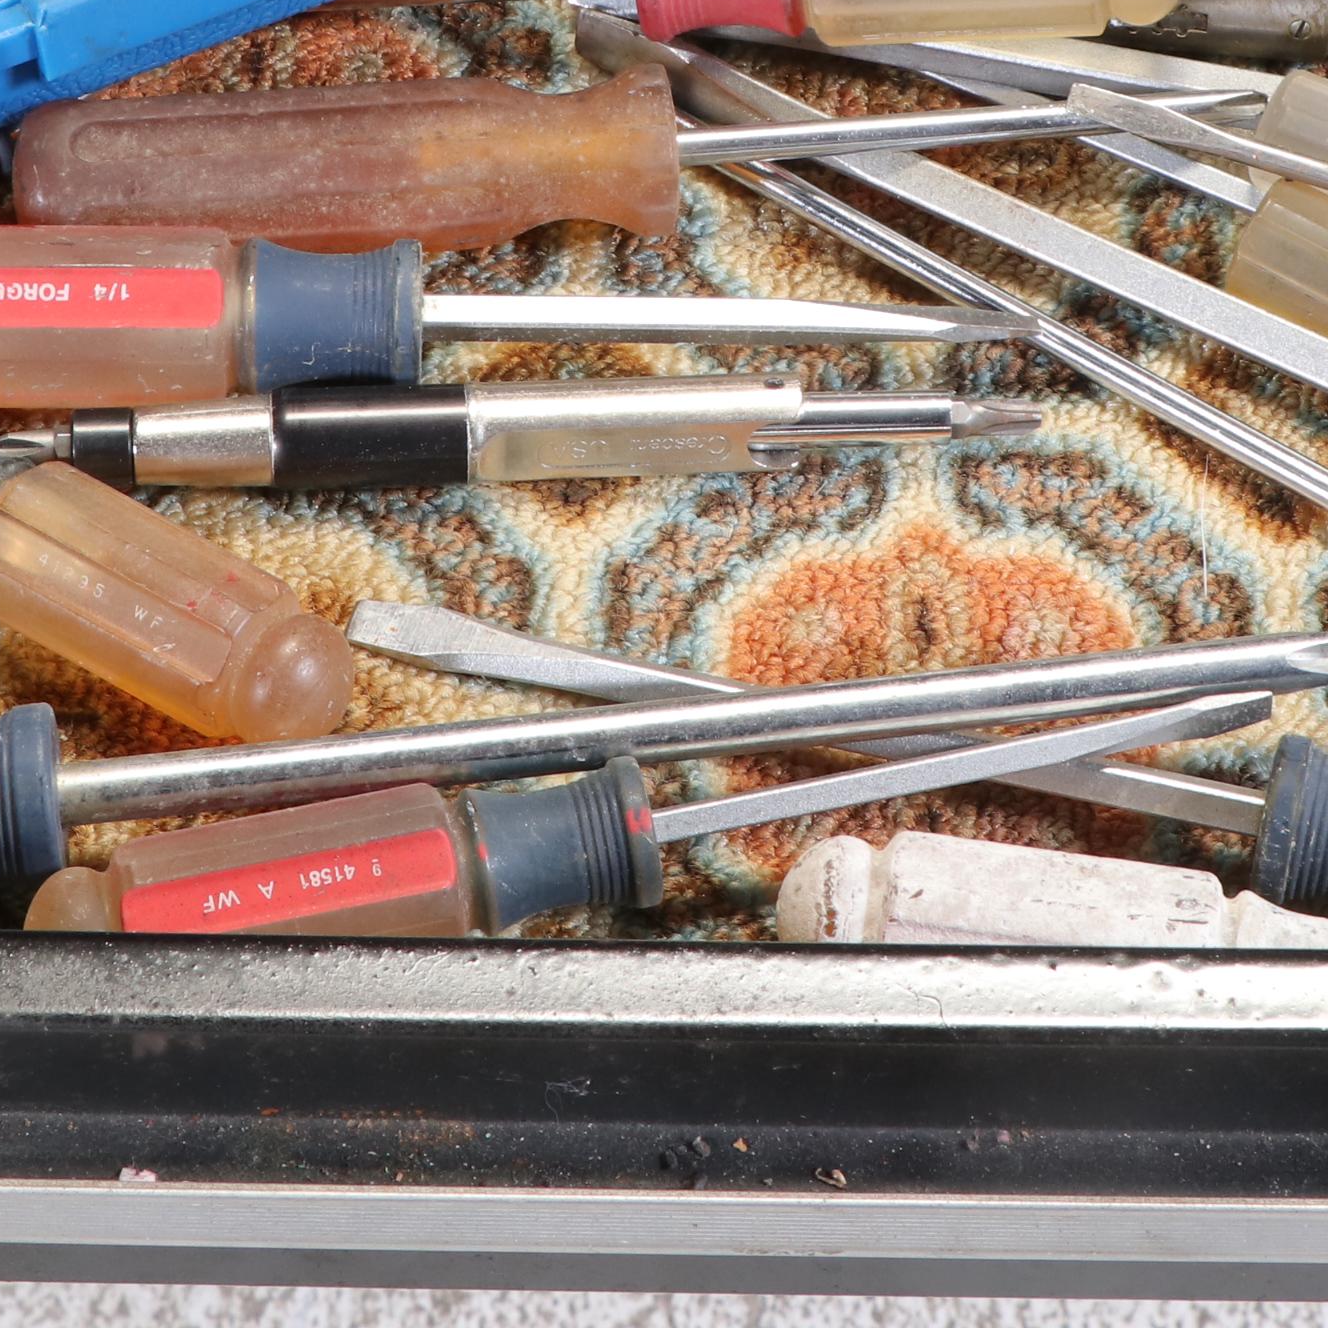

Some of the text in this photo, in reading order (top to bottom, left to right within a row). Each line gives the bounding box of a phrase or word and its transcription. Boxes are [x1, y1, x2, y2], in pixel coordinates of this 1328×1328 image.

[93, 283, 130, 301] 1/4
[299, 863, 356, 890] 41581
[257, 881, 274, 900] A
[203, 890, 241, 913] WF
